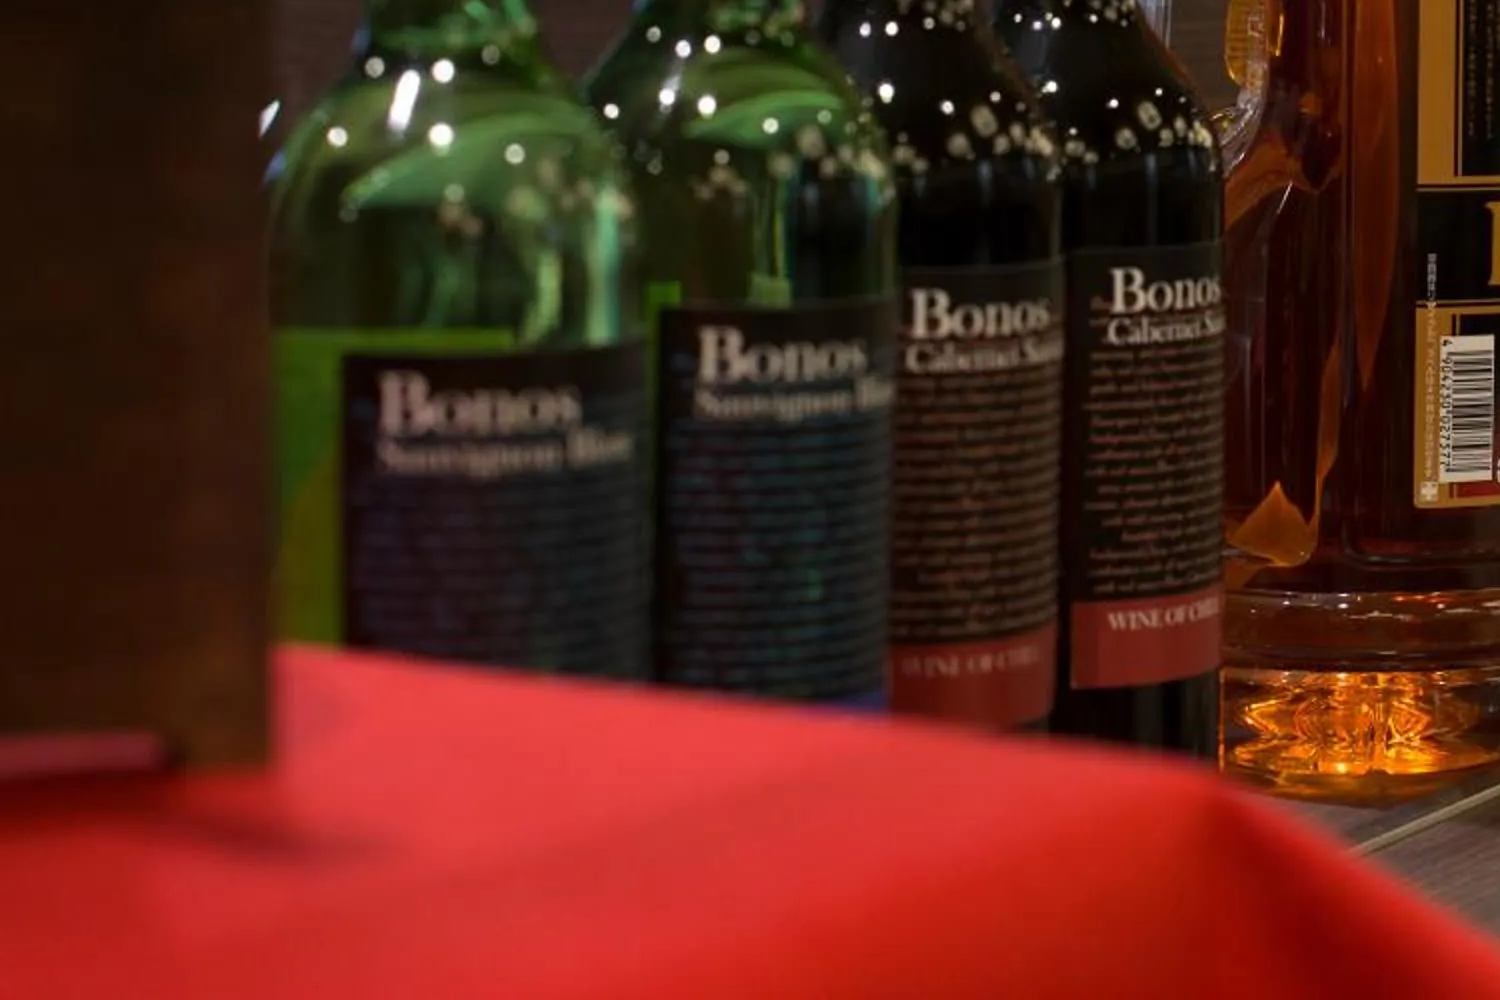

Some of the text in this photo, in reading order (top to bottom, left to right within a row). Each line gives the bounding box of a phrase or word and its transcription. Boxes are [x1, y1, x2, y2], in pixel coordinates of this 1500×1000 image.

[910, 286, 1051, 341] Bonos
[1108, 265, 1221, 315] Bonos
[697, 325, 868, 384] Bonos
[1105, 315, 1201, 346] Cabernet
[904, 341, 1021, 375] Cabernet
[378, 370, 582, 438] Bonos
[1107, 607, 1162, 632] WINE
[1164, 604, 1187, 627] OF
